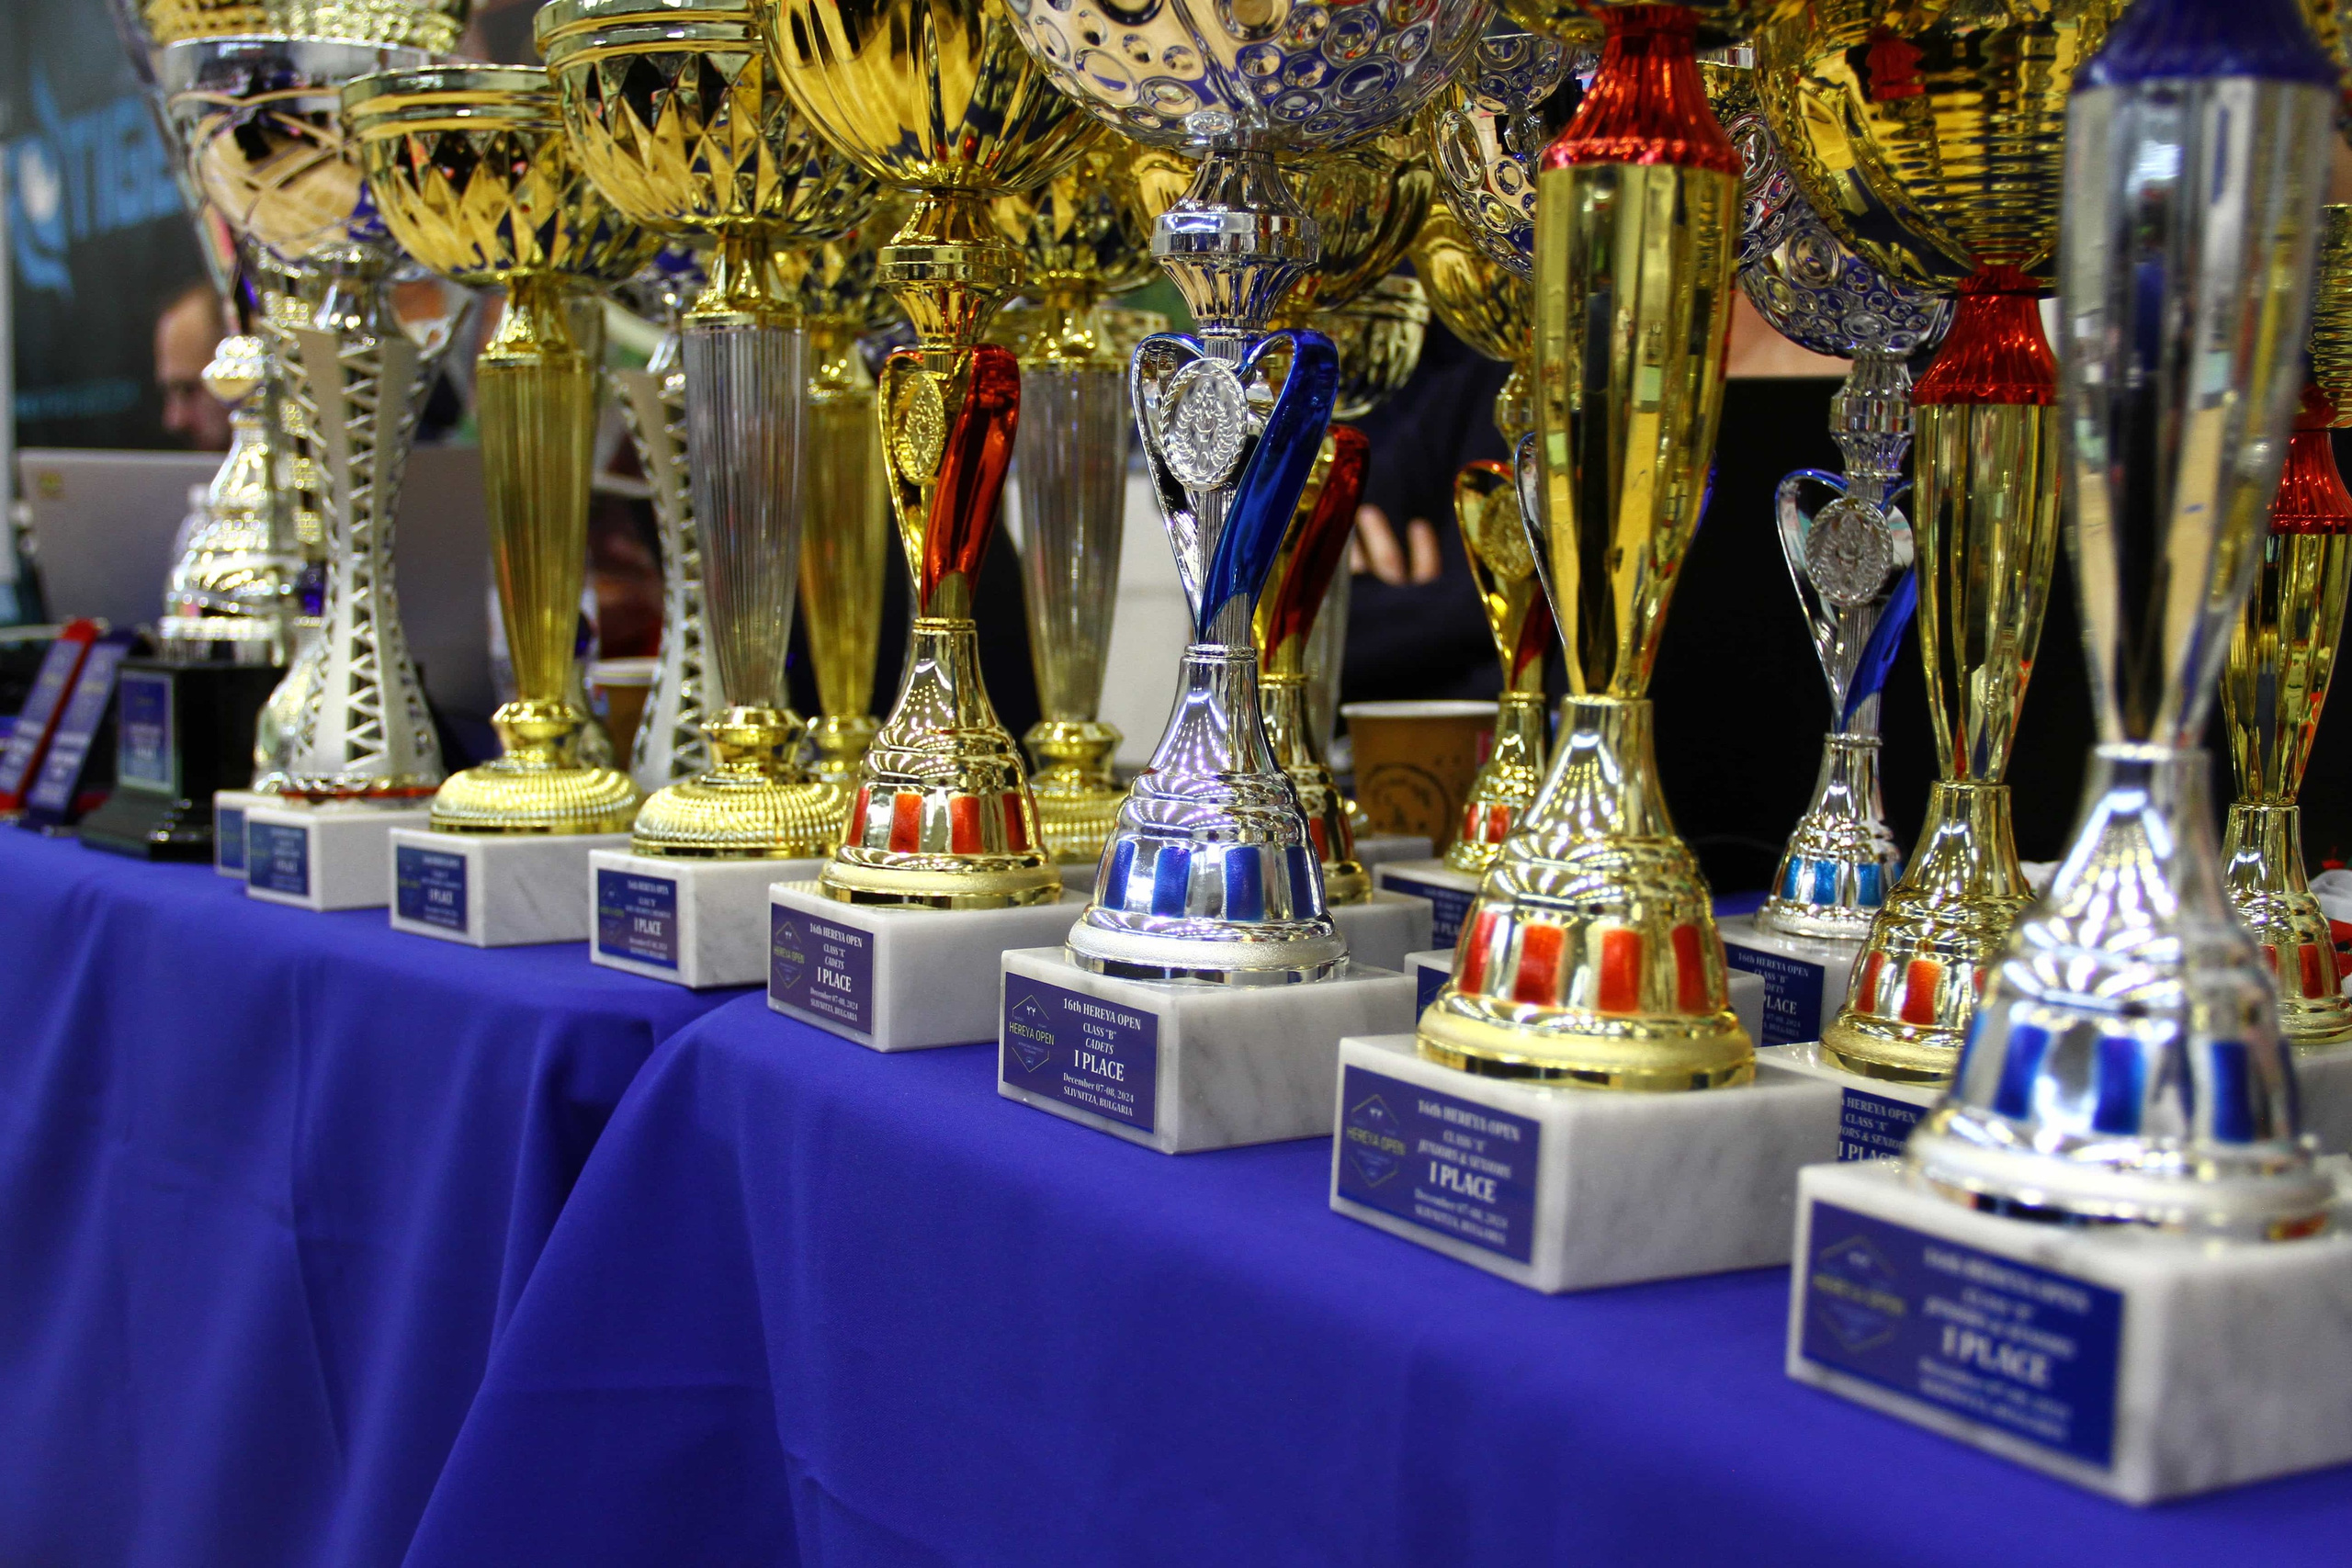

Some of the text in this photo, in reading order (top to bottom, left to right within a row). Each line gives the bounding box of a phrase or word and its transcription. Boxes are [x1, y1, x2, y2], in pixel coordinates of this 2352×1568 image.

[639, 918, 662, 936] PLACE
[809, 922, 863, 948] 16th HEREYA OPEN
[791, 951, 805, 964] OPEN
[823, 943, 839, 956] CLASS
[824, 955, 844, 970] CADETS
[1738, 952, 1809, 977] 16th HEREYA OPEN
[822, 968, 852, 992] PLACE
[1765, 983, 1785, 994] DETS
[1063, 998, 1141, 1031] 16th HEREYA OPEN
[1009, 1021, 1055, 1045] HEREYA OPEN
[1082, 1022, 1105, 1036] CLASS
[1085, 1037, 1114, 1055] CADETS
[1074, 1049, 1125, 1081] I PLACE
[1063, 1072, 1135, 1103] December 07-08, 2024
[1063, 1086, 1134, 1117] SLIVNITZA, BULGARIA
[1847, 1096, 1886, 1117] HEREYA
[1887, 1107, 1917, 1124] OPEN
[1845, 1112, 1874, 1129] CLASS
[1380, 1135, 1407, 1156] OPEN
[1429, 1160, 1498, 1204] I PLACE
[1958, 1330, 2050, 1388] PLACE
